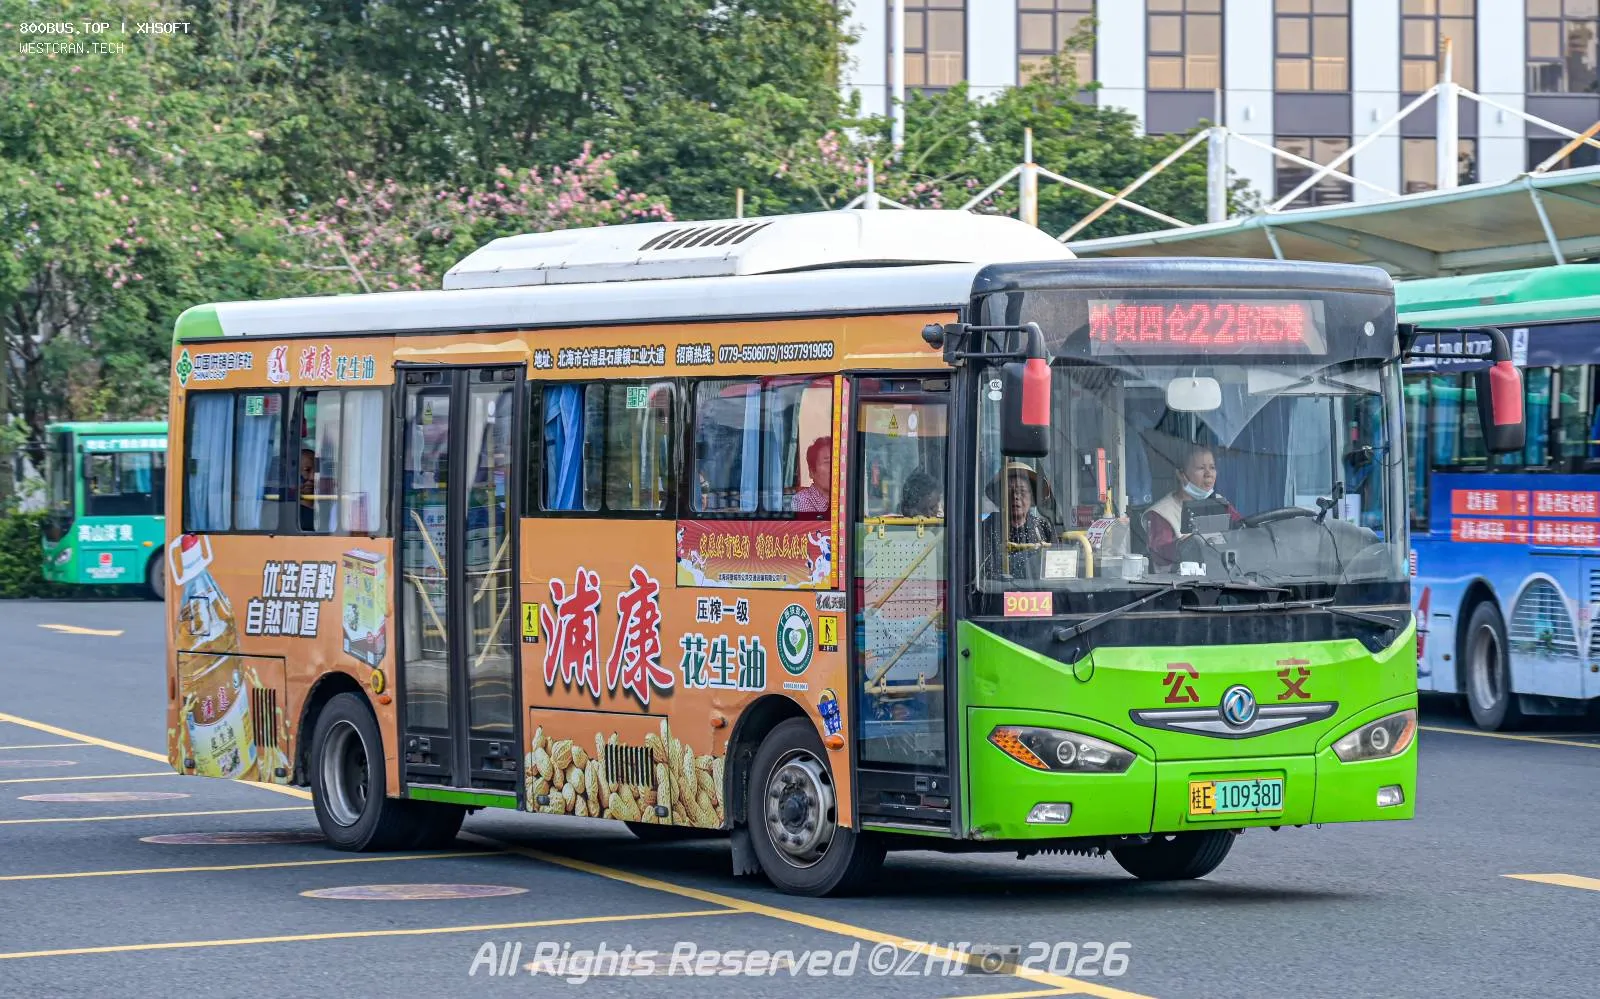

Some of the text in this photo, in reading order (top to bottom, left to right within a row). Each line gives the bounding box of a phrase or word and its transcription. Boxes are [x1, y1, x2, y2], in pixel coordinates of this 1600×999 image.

[718, 342, 834, 361] 0779-5506079/19377919058
[262, 560, 337, 601] 优选原料
[245, 597, 321, 637] 自然味道
[696, 599, 750, 623] 压榨一级
[1007, 596, 1051, 612] 9014
[541, 567, 674, 705] 浦康
[680, 633, 767, 692] 花生油
